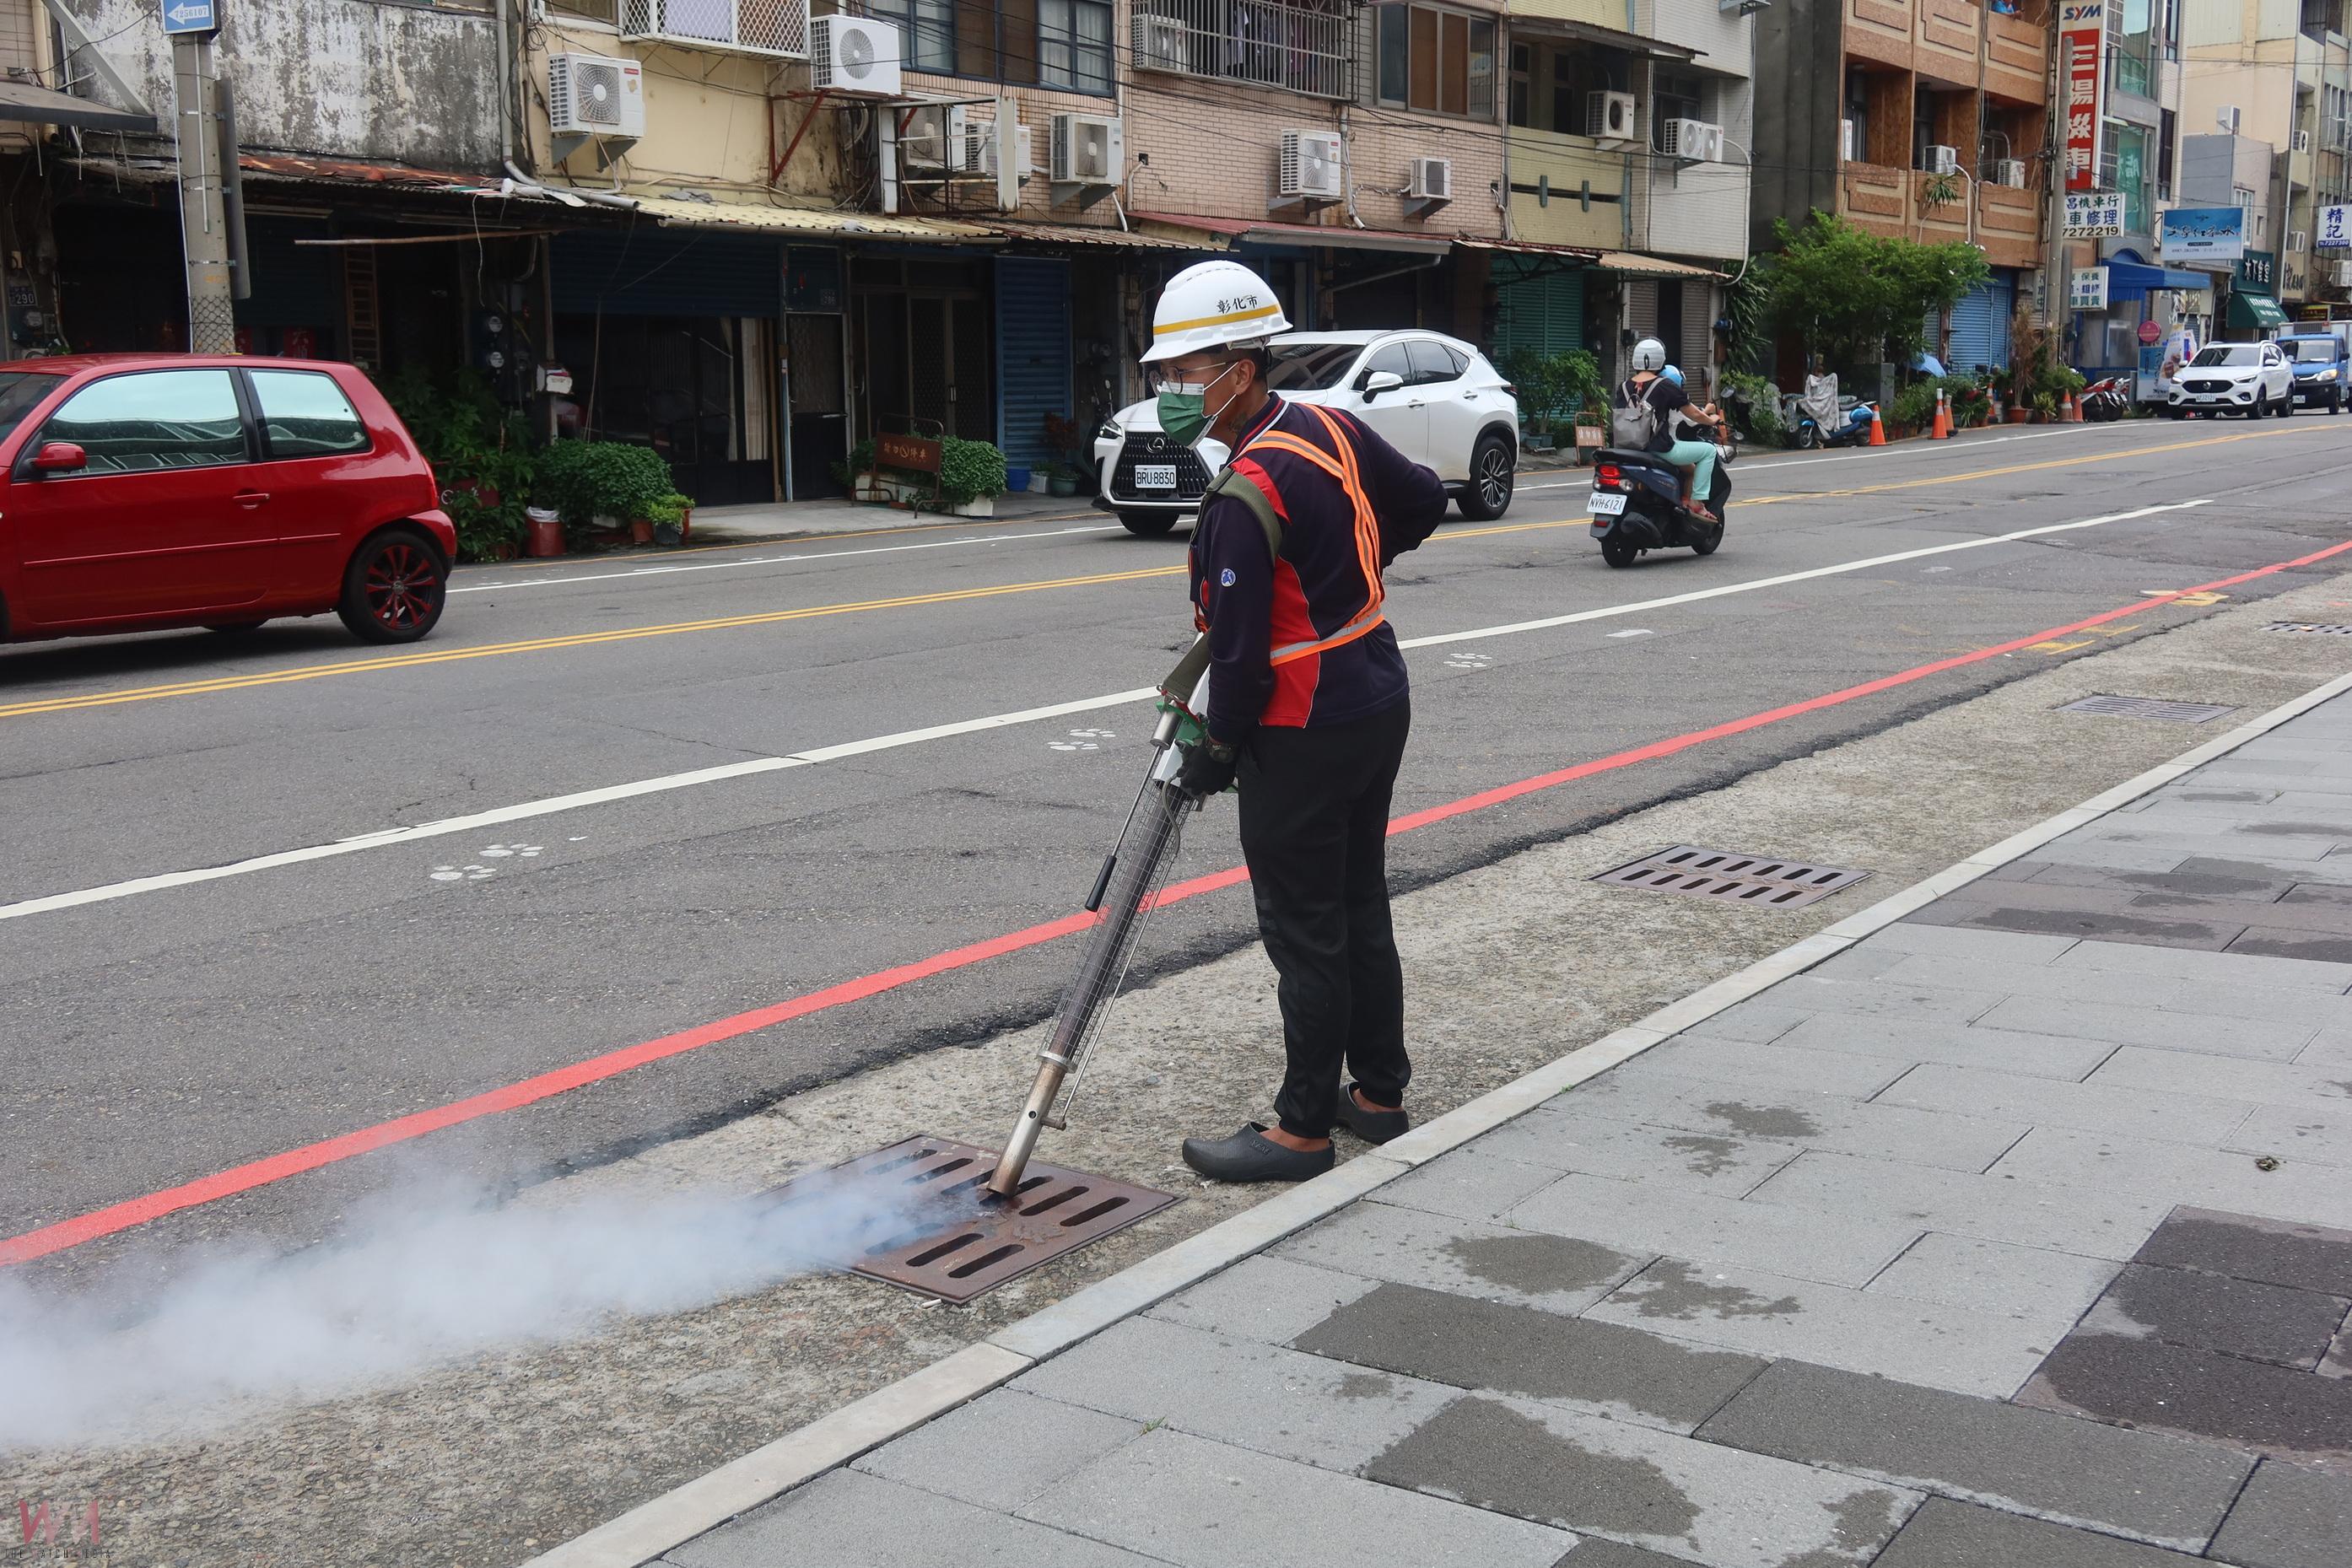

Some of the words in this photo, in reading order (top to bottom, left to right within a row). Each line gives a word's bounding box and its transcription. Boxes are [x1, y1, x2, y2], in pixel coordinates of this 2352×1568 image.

[2063, 4, 2101, 21] SYM
[2066, 195, 2120, 209] 昌機車行
[2063, 209, 2117, 226] 車修理
[2326, 207, 2344, 239] 精記
[2063, 226, 2118, 237] 7272219
[1216, 296, 1257, 315] 彰化市
[1136, 471, 1175, 485] BRU-8830
[1589, 498, 1623, 510] NVH-6121
